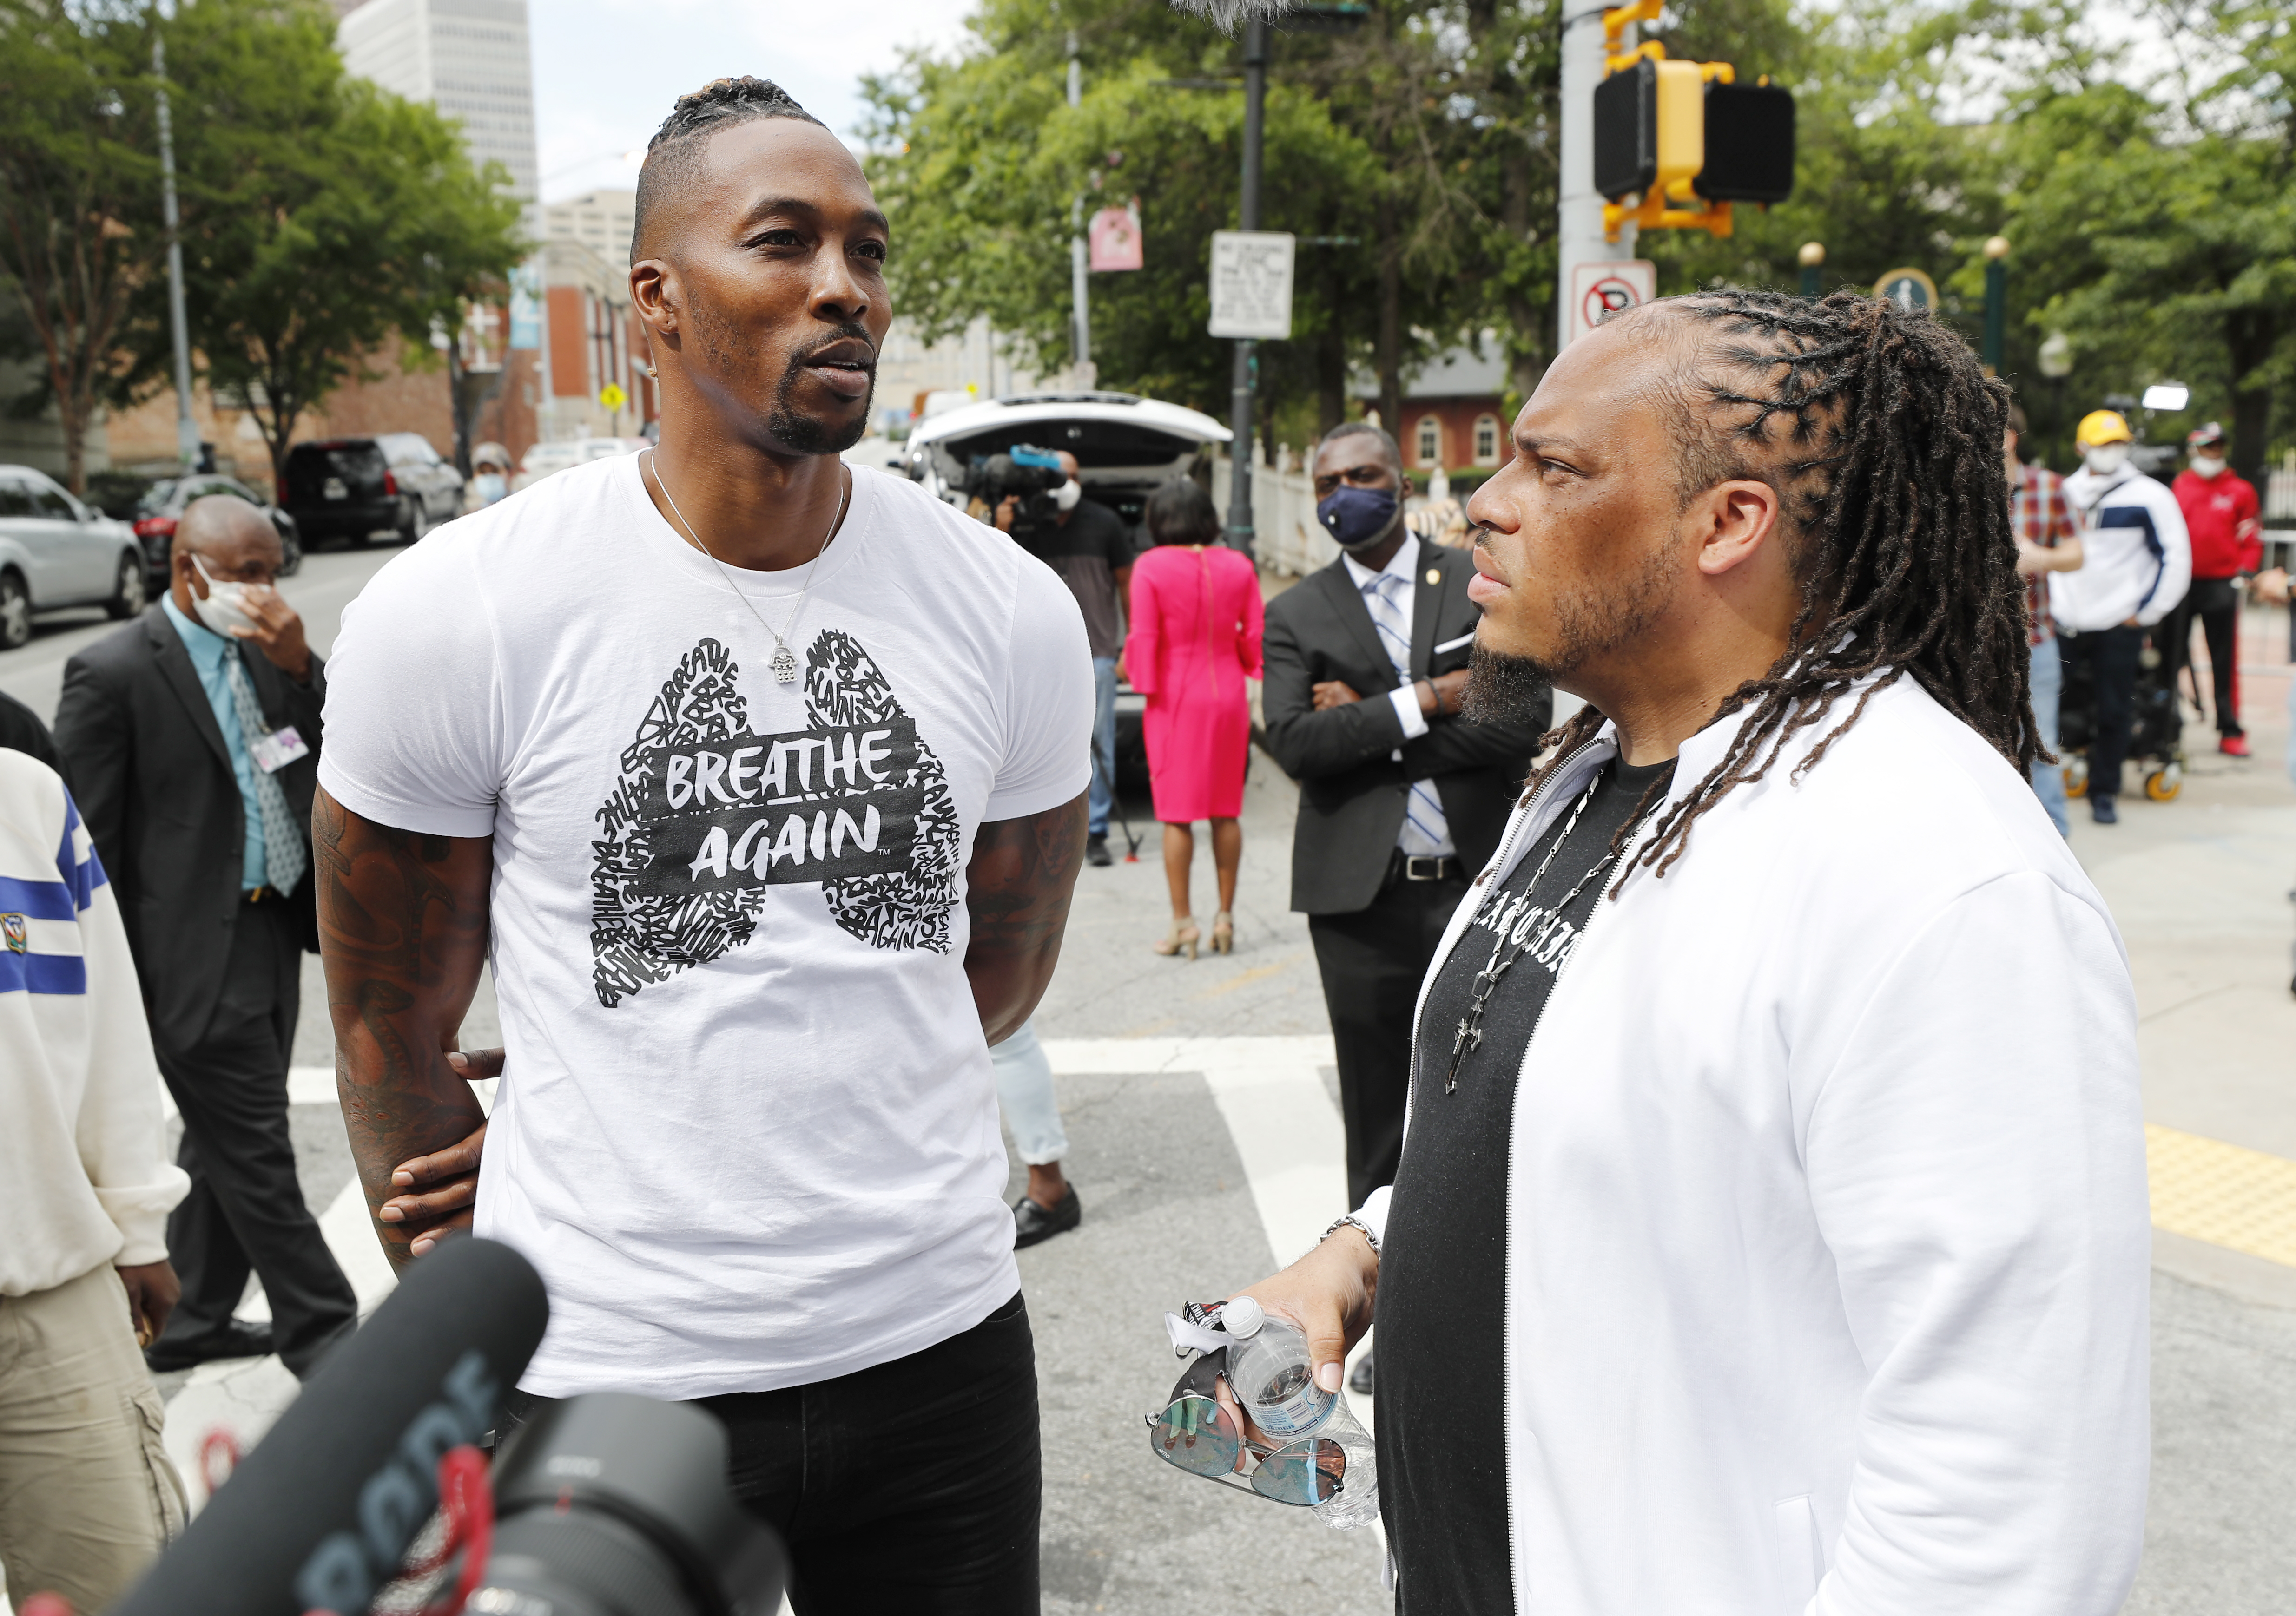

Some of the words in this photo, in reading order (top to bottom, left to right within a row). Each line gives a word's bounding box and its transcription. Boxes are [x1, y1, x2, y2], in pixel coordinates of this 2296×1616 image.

[666, 729, 894, 809] BREATHE
[688, 804, 881, 883] AGAIN
[1190, 1303, 1206, 1322] TAKE
[1157, 1448, 1170, 1458] QUAY
